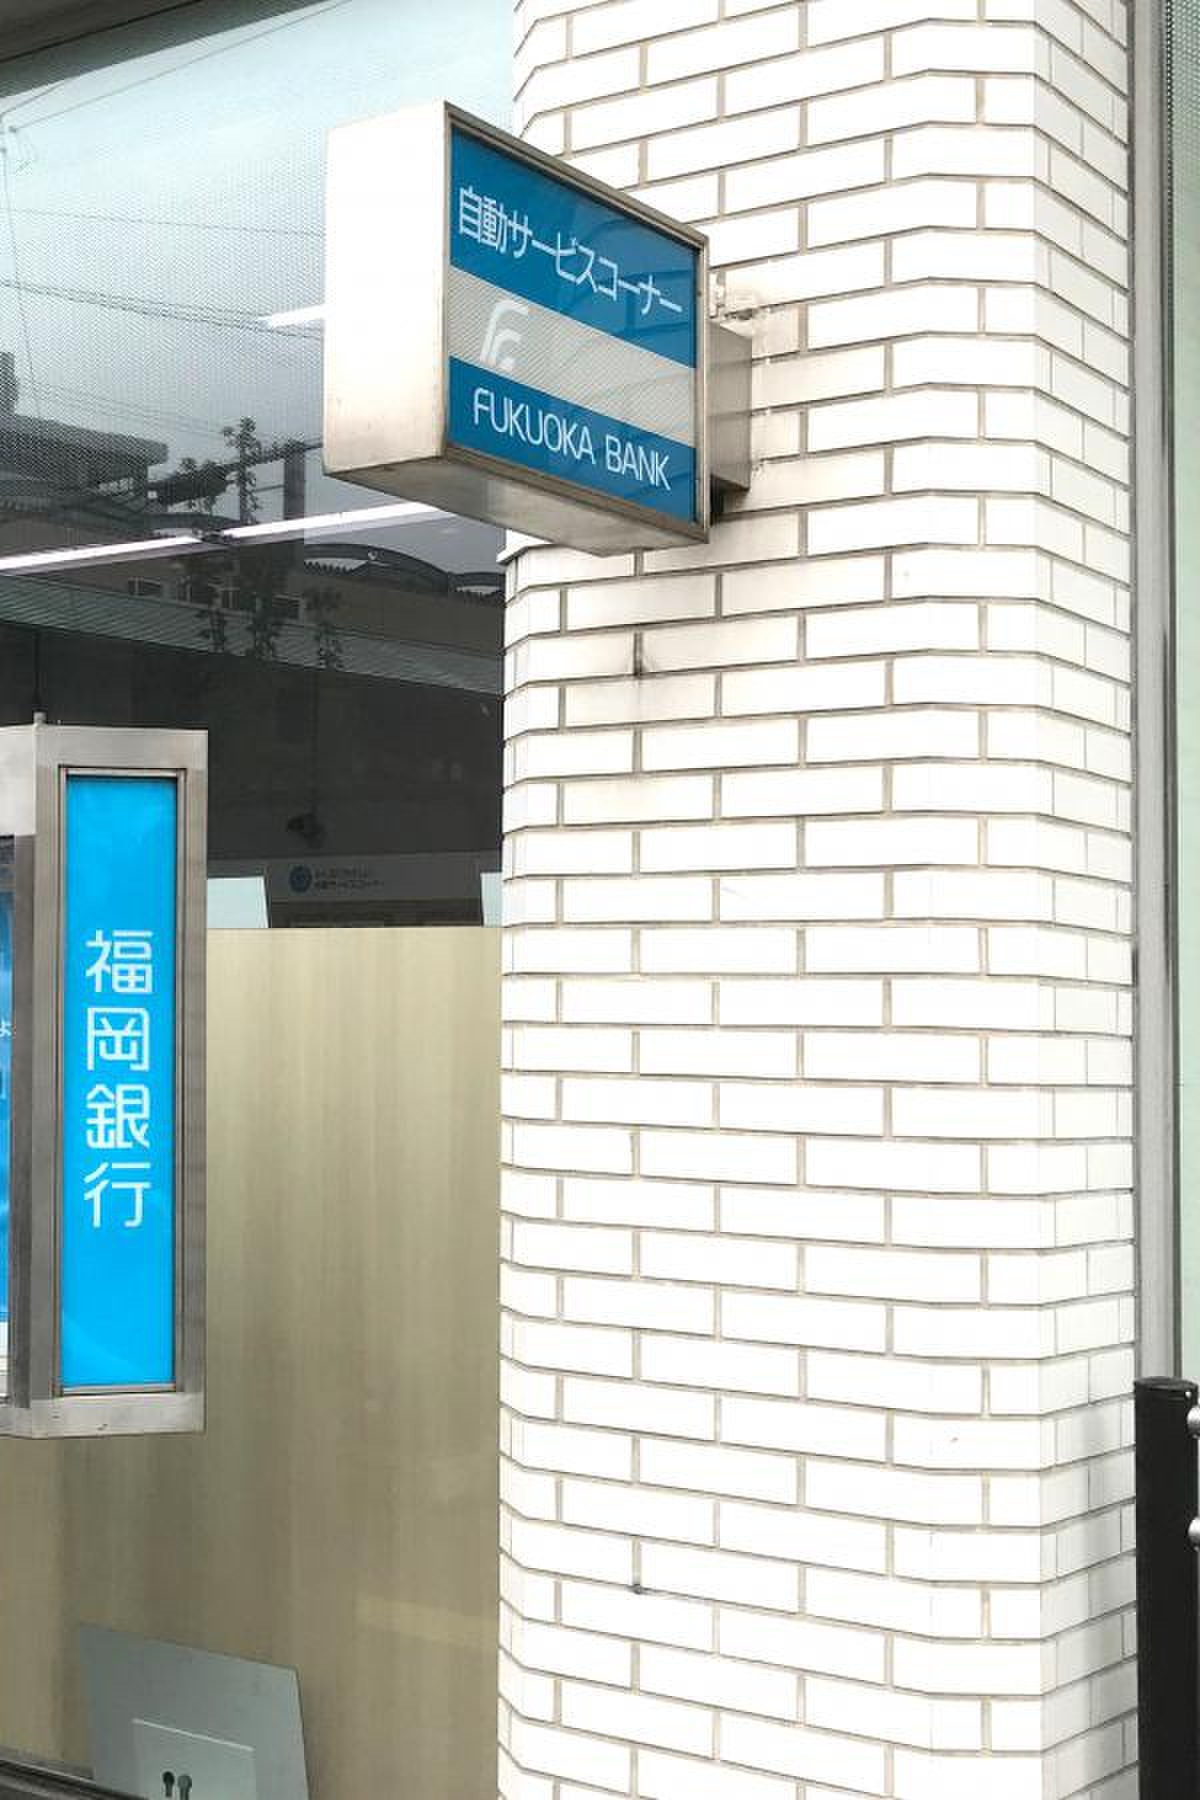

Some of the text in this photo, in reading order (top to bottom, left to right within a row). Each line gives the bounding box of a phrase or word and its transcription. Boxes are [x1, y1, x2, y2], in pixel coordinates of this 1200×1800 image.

[458, 186, 683, 314] 自動サービスコーナー
[473, 387, 672, 491] FUKUOKA BANK
[83, 929, 153, 1228] 福岡銀行
